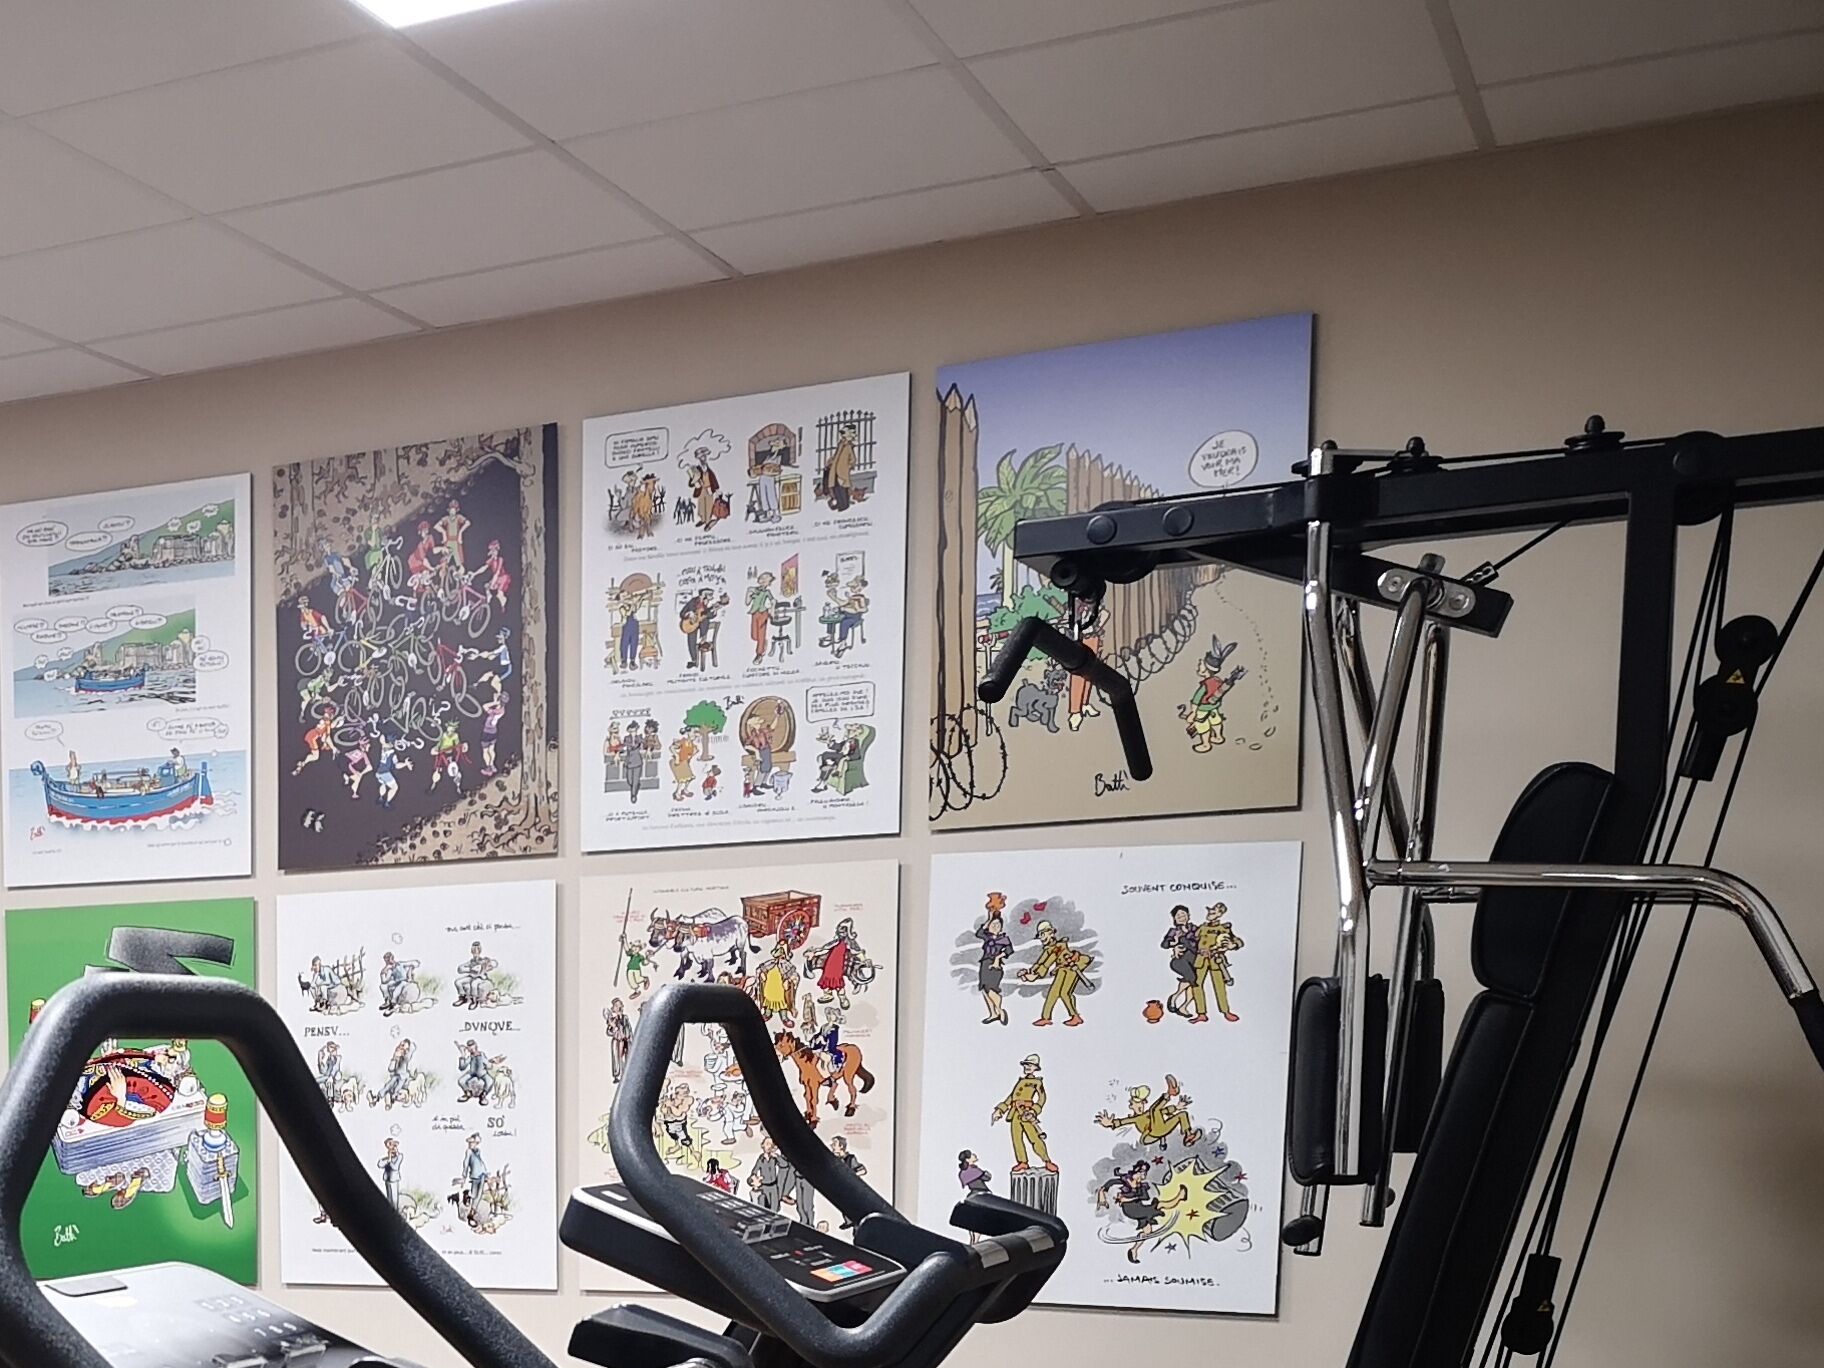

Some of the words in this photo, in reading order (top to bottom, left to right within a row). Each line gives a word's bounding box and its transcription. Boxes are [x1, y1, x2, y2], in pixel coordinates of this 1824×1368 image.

[1212, 439, 1225, 450] JE
[1200, 458, 1223, 471] VOIR
[1225, 457, 1241, 466] MA
[1121, 884, 1166, 895] SOUVENT
